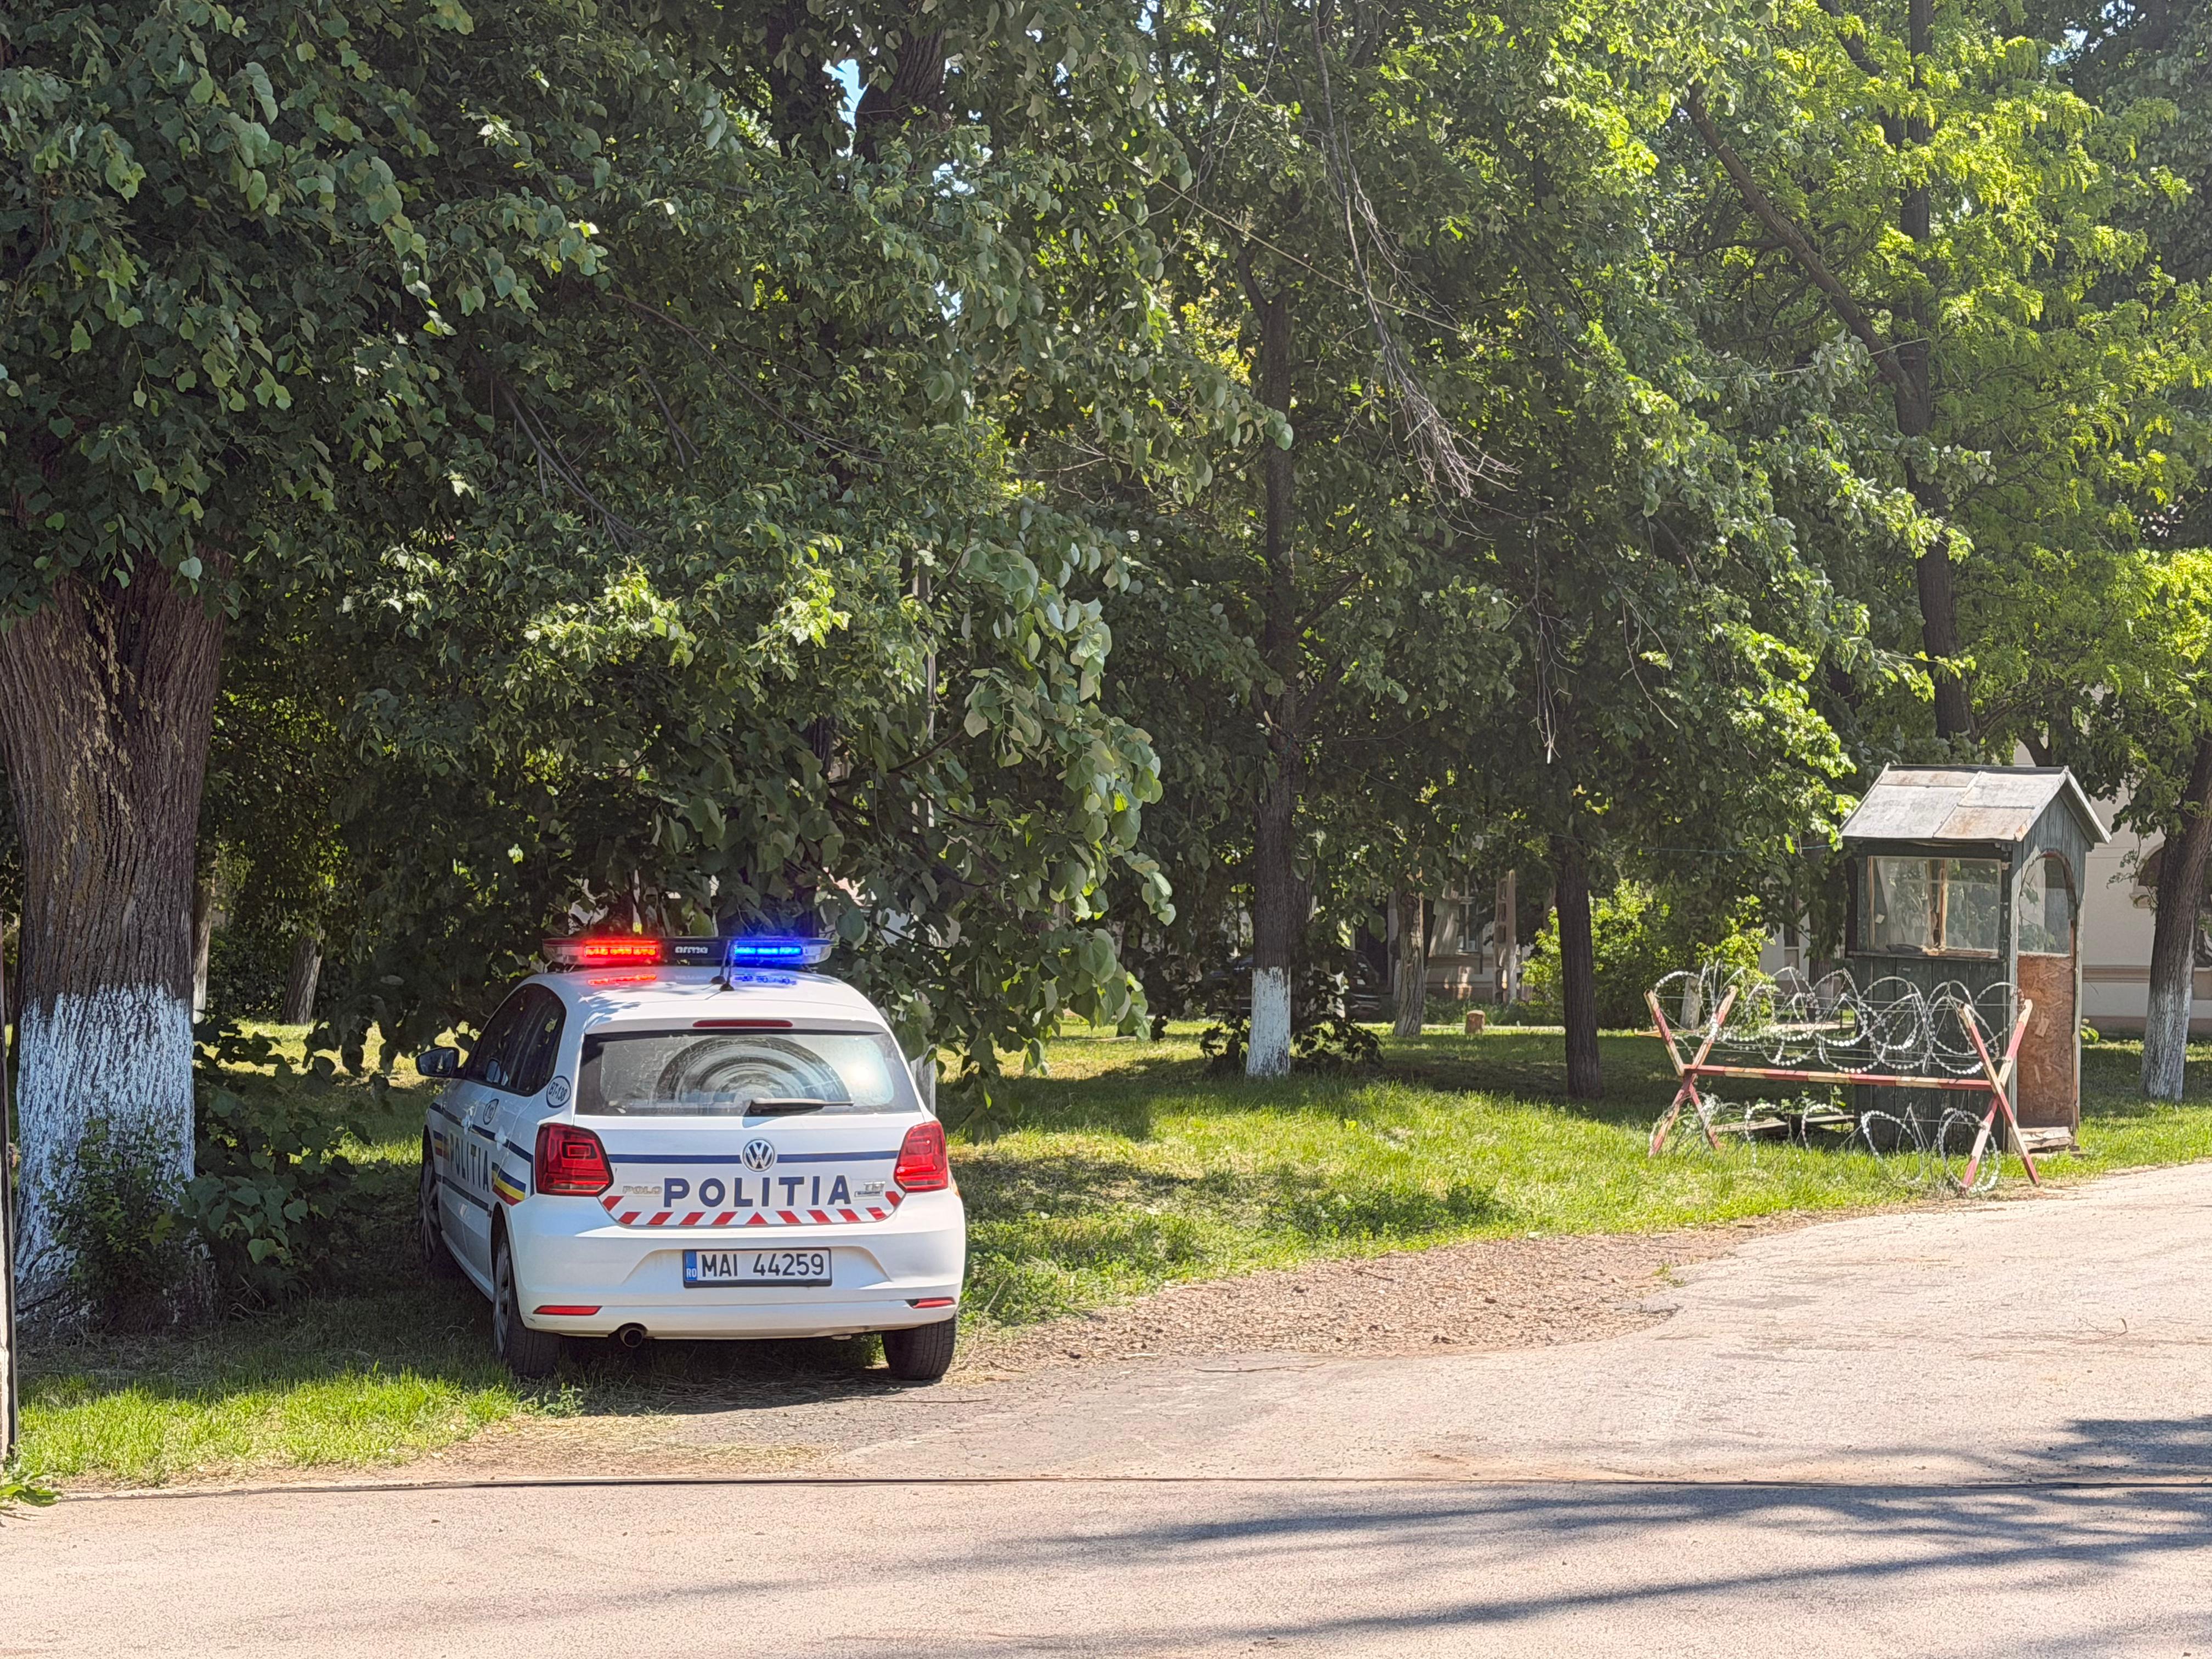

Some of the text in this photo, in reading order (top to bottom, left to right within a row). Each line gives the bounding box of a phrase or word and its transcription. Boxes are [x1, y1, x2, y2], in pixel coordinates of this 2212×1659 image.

[450, 1132, 489, 1193] POLITIA
[622, 1186, 662, 1194] POLO
[664, 1175, 851, 1207] POLITIA
[686, 1268, 697, 1278] RO
[701, 1253, 824, 1277] MAI 44259
